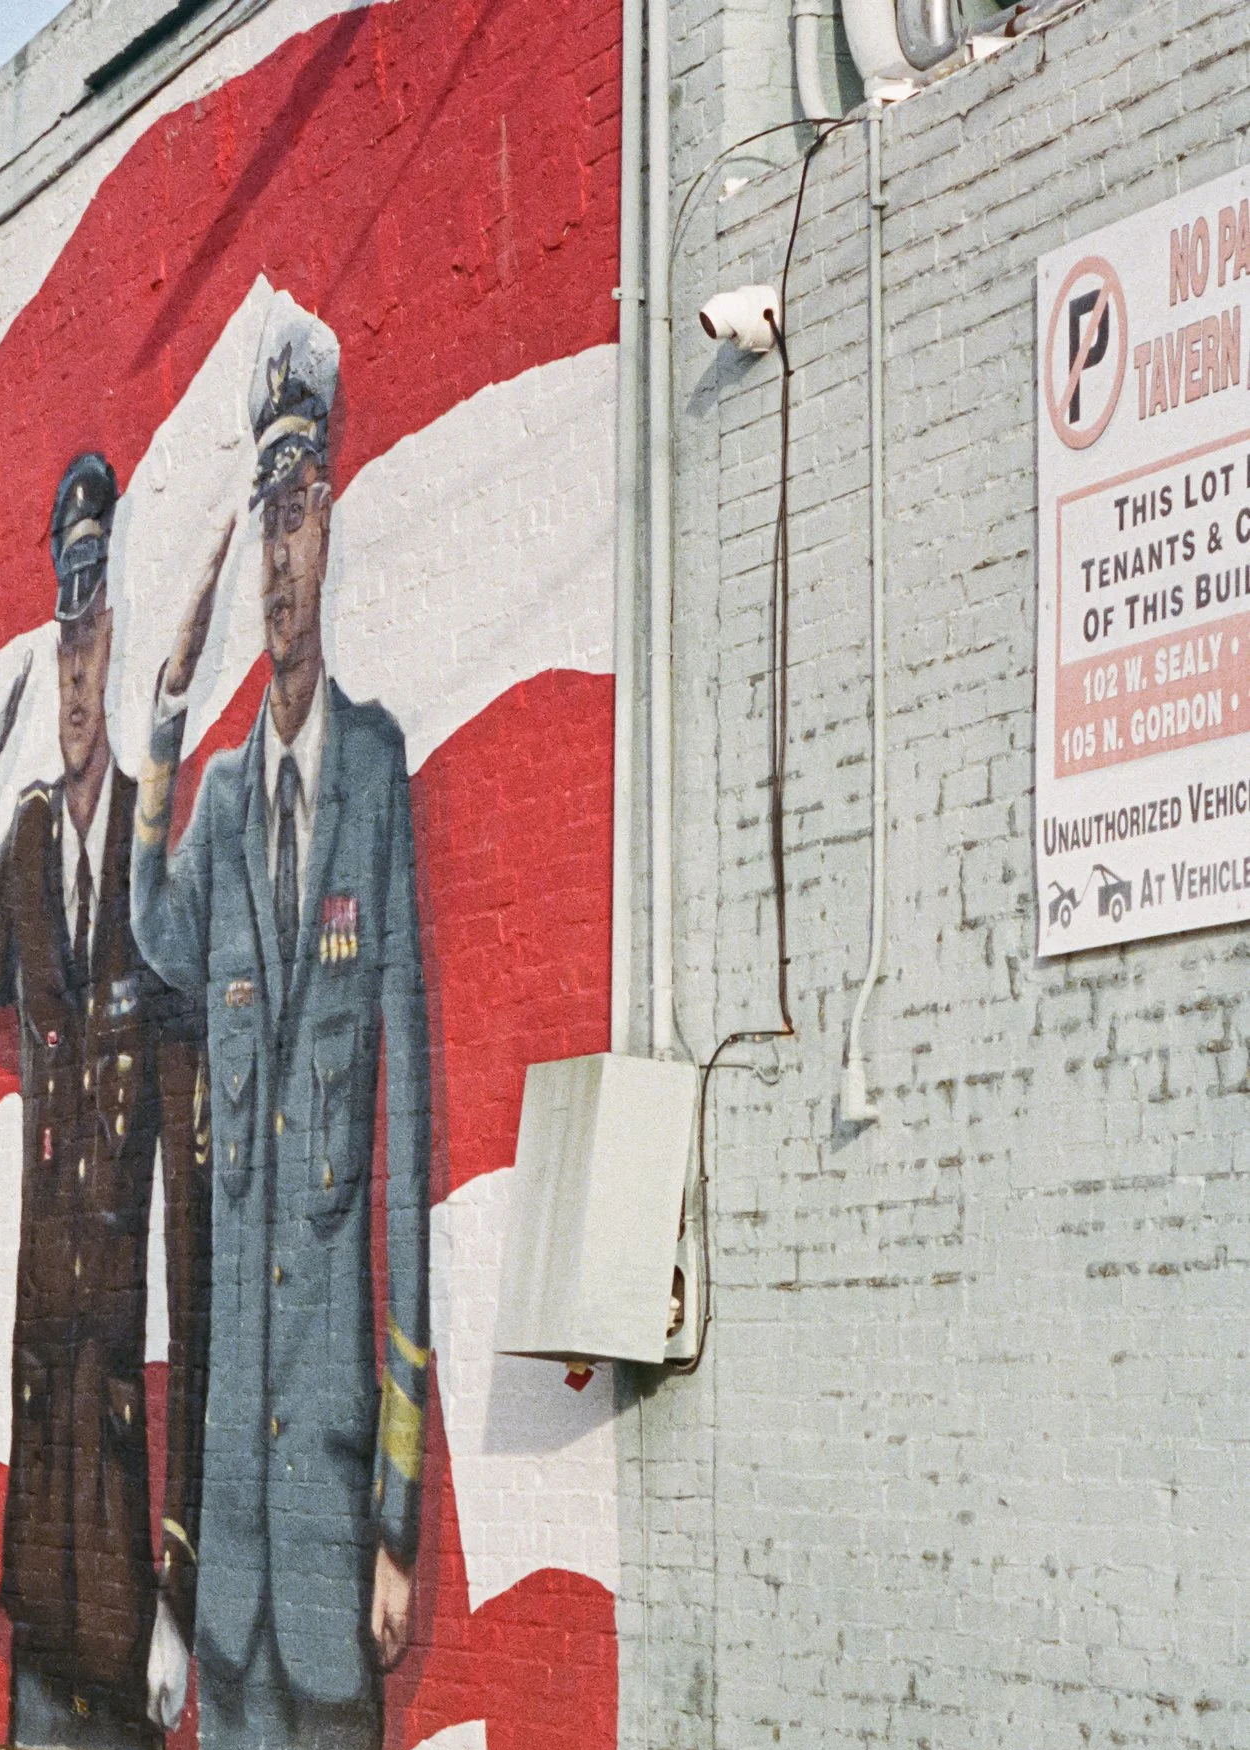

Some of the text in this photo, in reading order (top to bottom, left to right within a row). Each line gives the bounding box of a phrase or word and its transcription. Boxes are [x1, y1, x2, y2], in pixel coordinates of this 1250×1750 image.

[1170, 215, 1210, 307] NO
[1133, 305, 1241, 421] TAVERN
[1114, 484, 1173, 531] THIS
[1184, 463, 1234, 510] LOT
[1081, 529, 1196, 593] TENANTS
[1207, 521, 1223, 554] &
[1083, 605, 1114, 643] OF
[1124, 584, 1184, 631] THIS
[1082, 631, 1224, 706] 102 W. SEALY
[1061, 688, 1223, 764] 105 N. GORDON
[1043, 796, 1181, 858] UNAUTHORIZED
